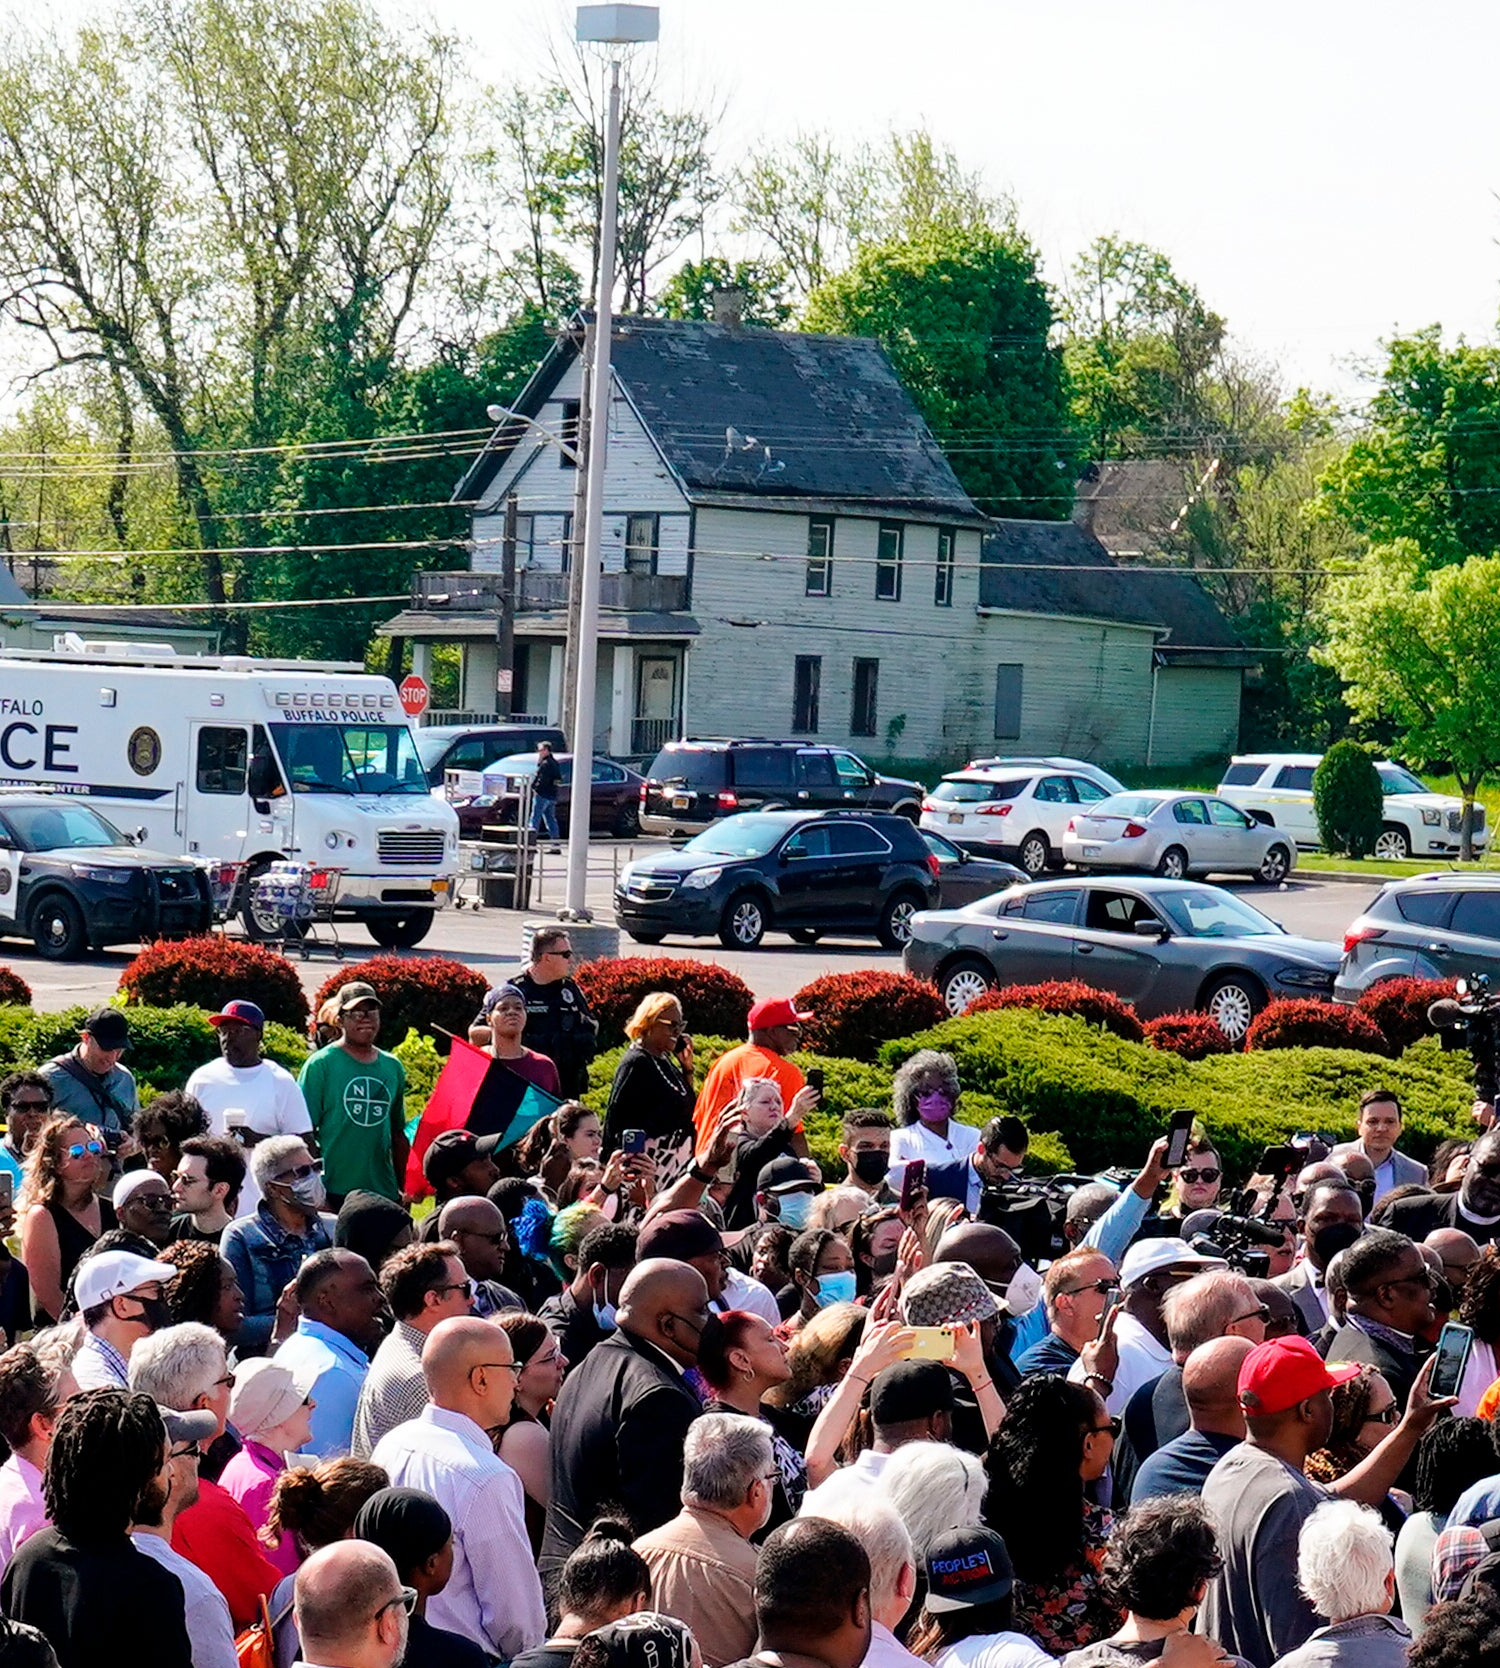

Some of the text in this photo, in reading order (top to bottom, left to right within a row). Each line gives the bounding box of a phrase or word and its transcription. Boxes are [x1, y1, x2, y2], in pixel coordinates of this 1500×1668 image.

[402, 687, 426, 703] STOP
[283, 709, 386, 722] BUFFALO POLICE
[353, 1084, 365, 1097] N
[353, 1103, 383, 1117] 8 3
[932, 1551, 986, 1575] PEOPLE'S
[943, 1565, 990, 1584] ACTION
